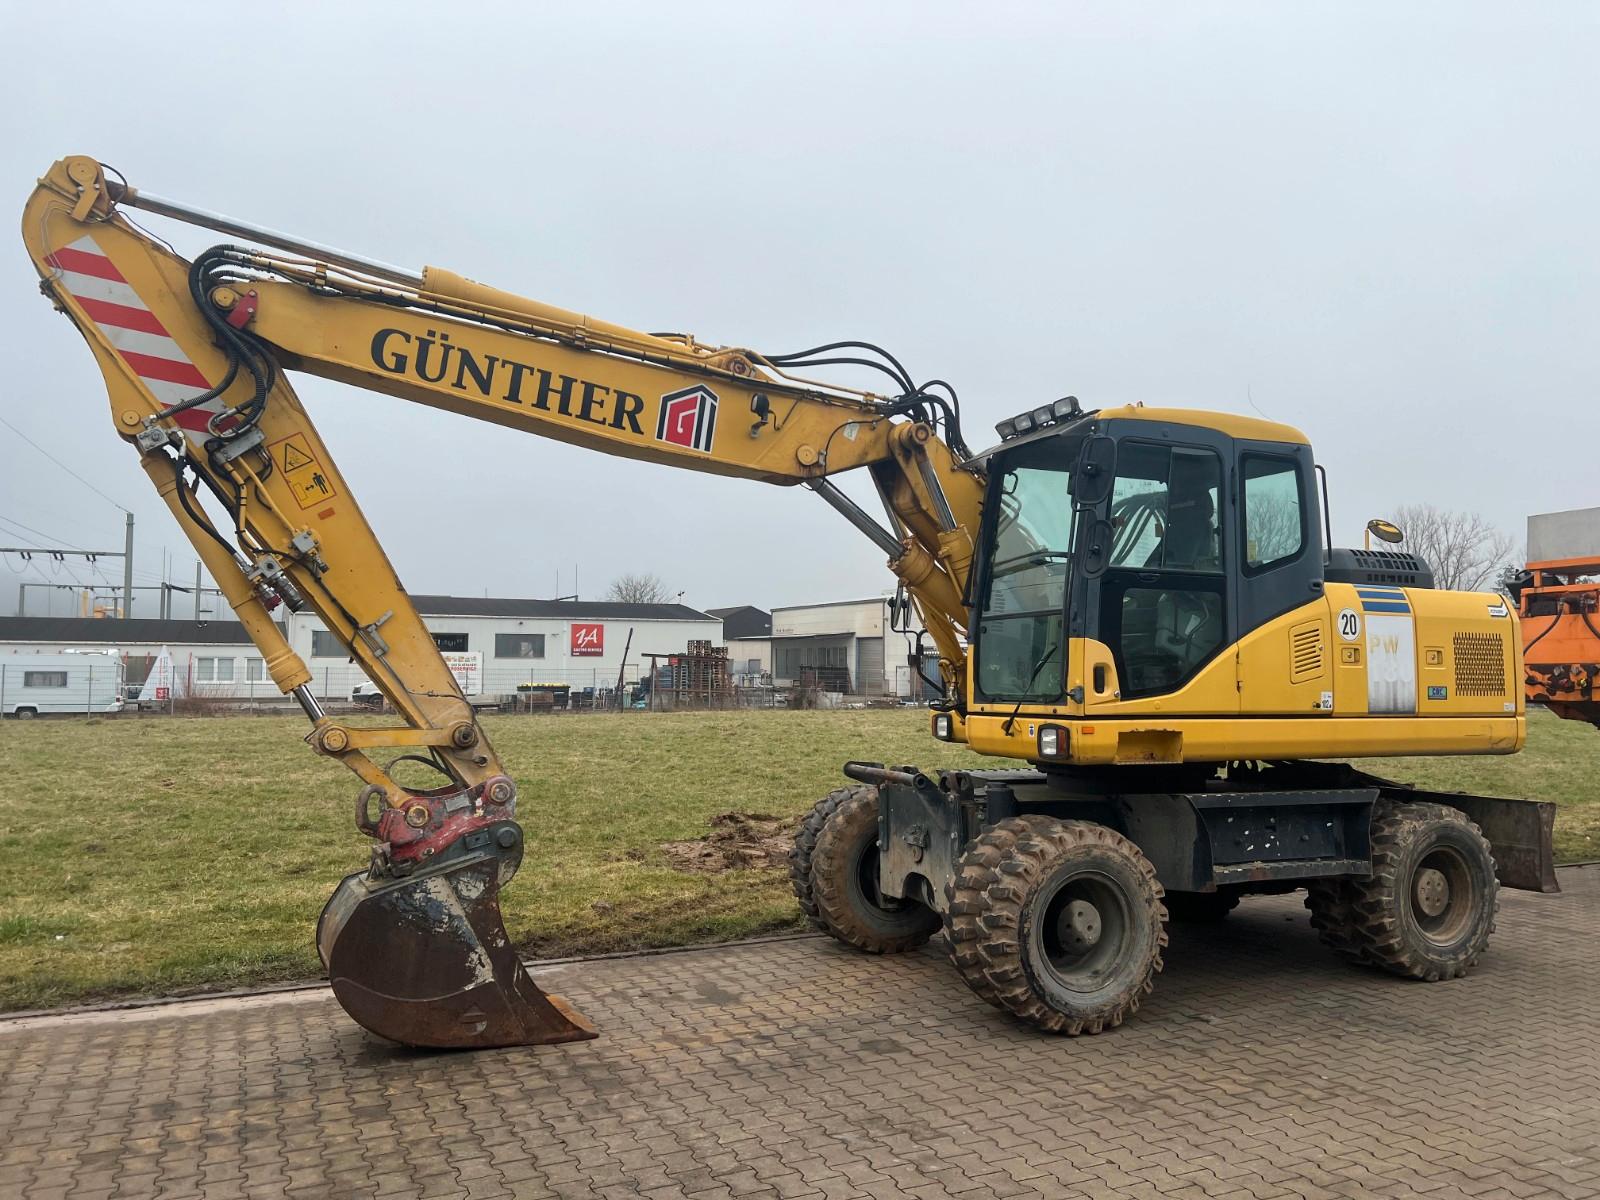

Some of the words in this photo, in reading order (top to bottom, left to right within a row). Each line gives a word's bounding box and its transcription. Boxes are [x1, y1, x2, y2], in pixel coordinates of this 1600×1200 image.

[370, 328, 645, 435] GÜNTHER
[1341, 613, 1357, 635] 20
[576, 628, 598, 648] 1A
